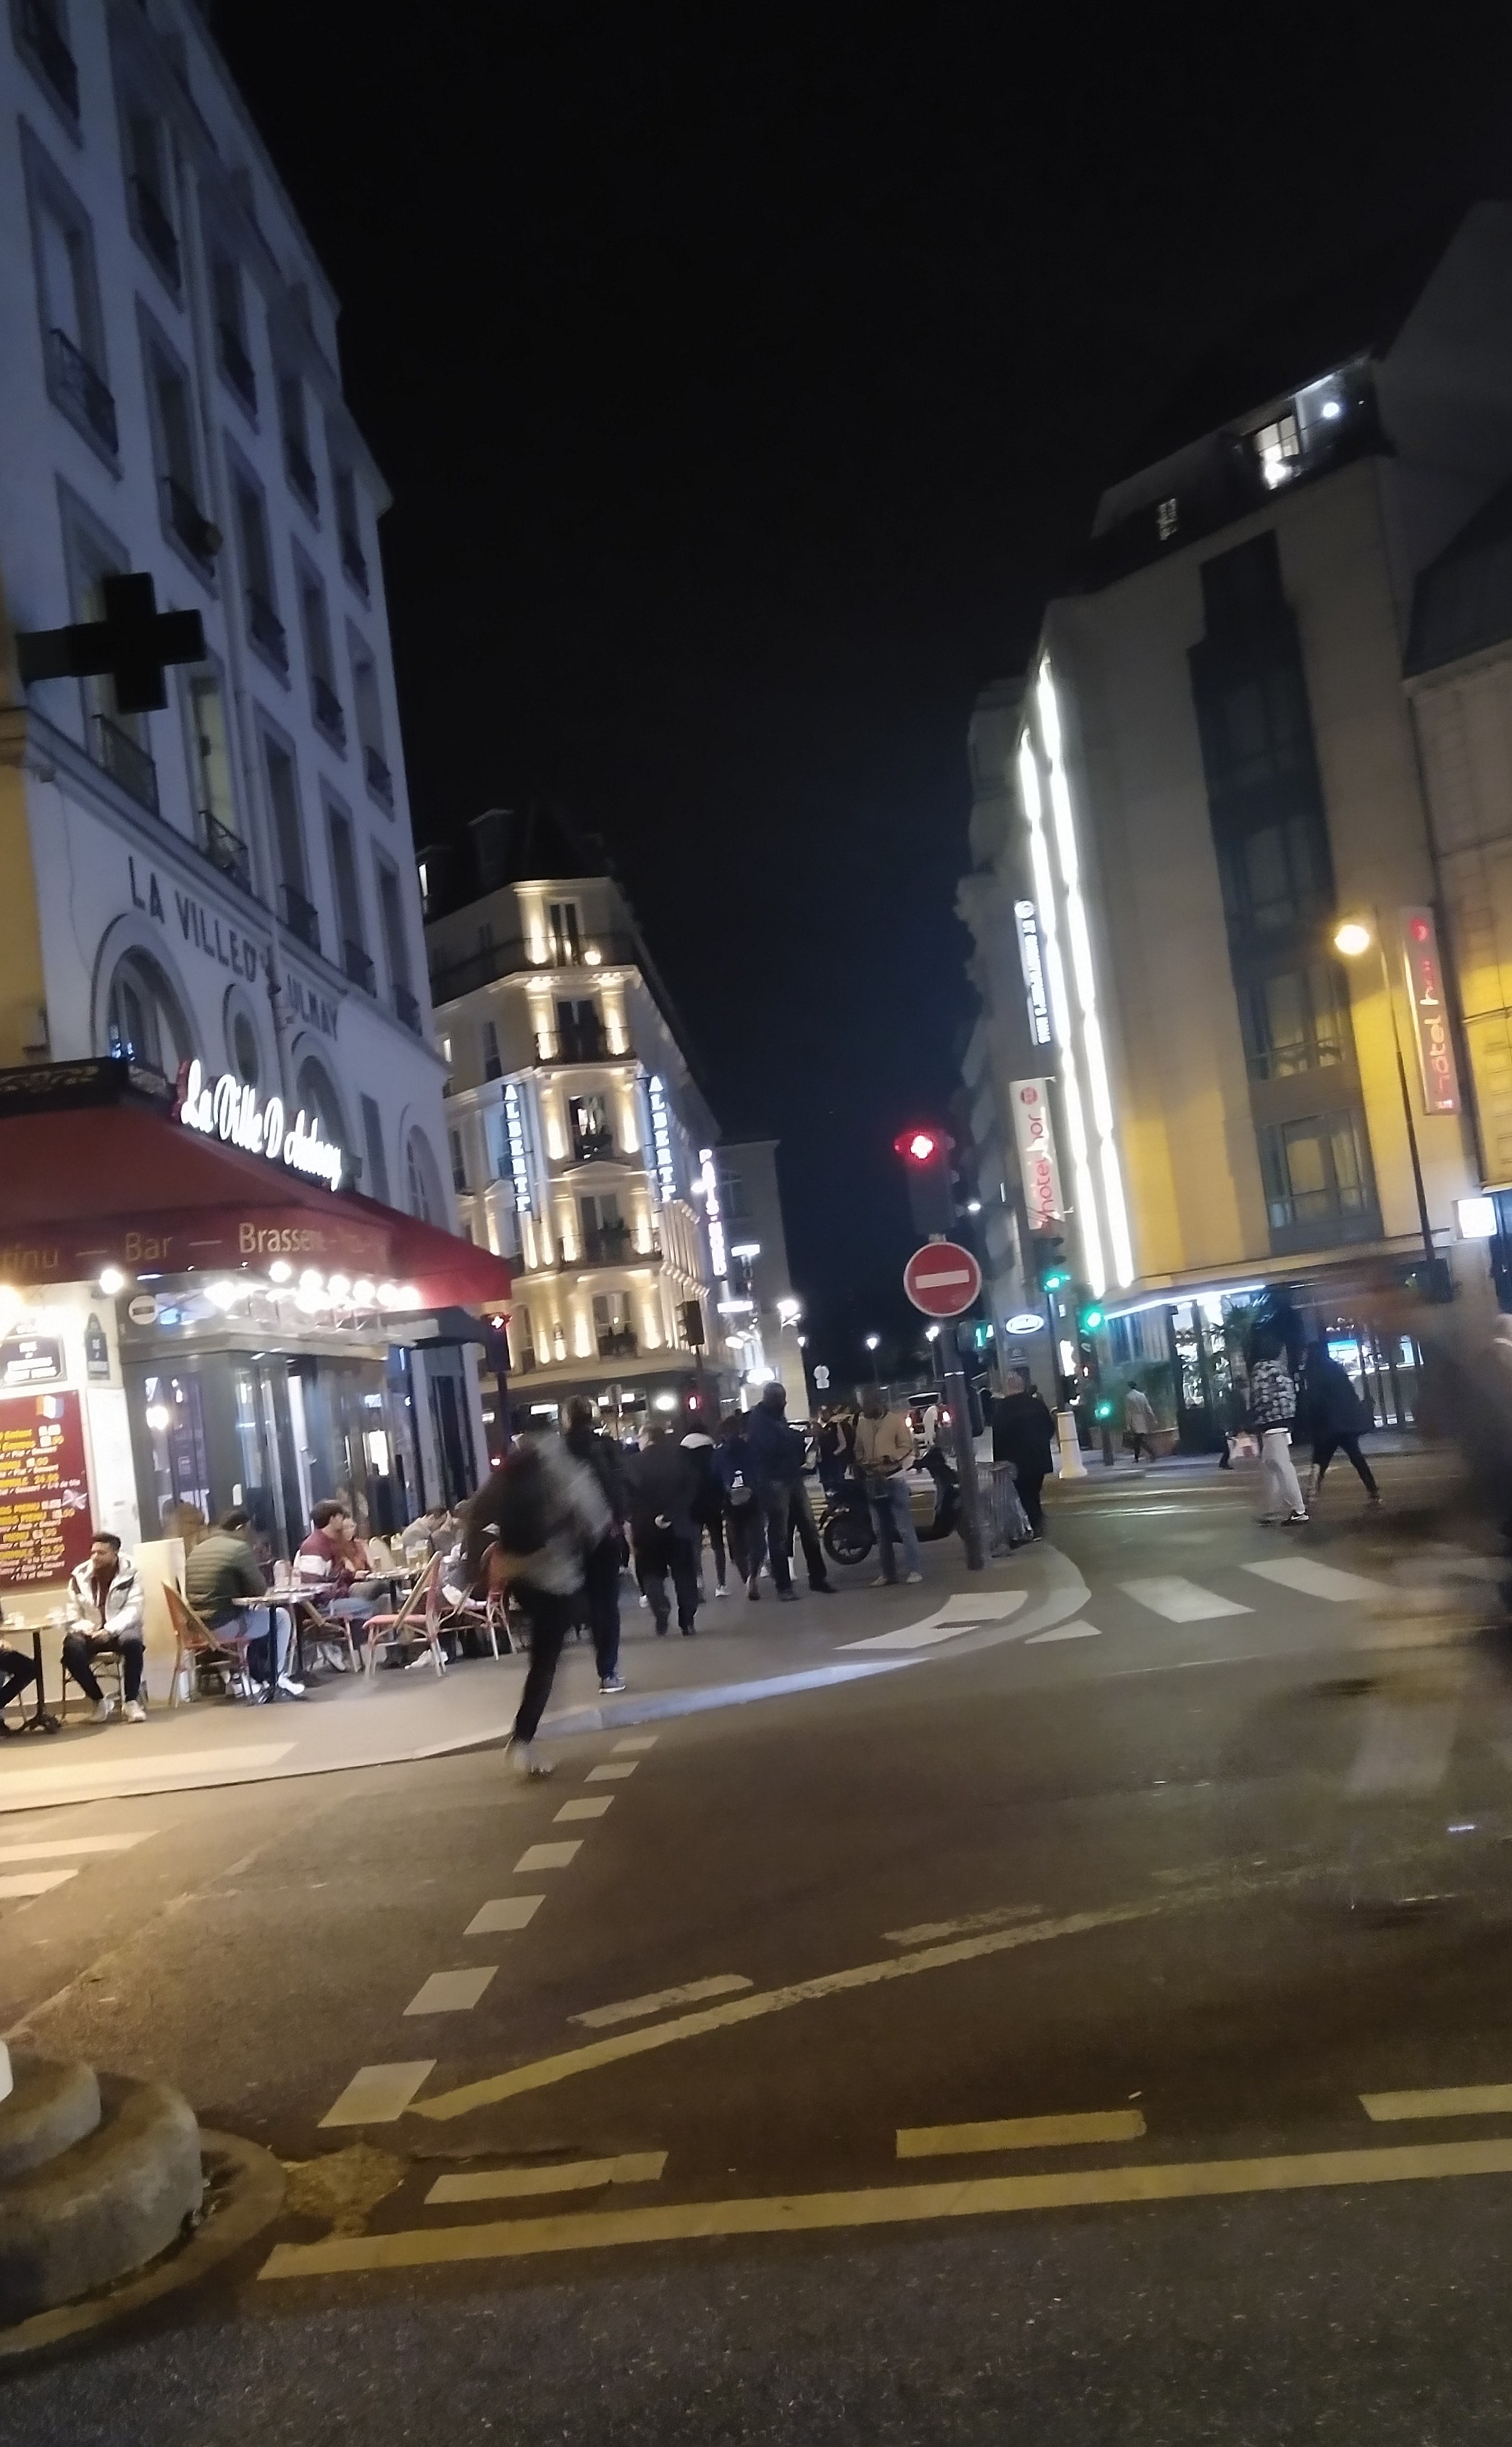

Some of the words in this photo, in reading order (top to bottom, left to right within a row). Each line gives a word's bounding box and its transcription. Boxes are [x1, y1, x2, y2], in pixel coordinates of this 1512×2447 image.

[128, 855, 165, 925] LA
[175, 889, 245, 976] VILLE
[125, 1231, 172, 1262] Bar
